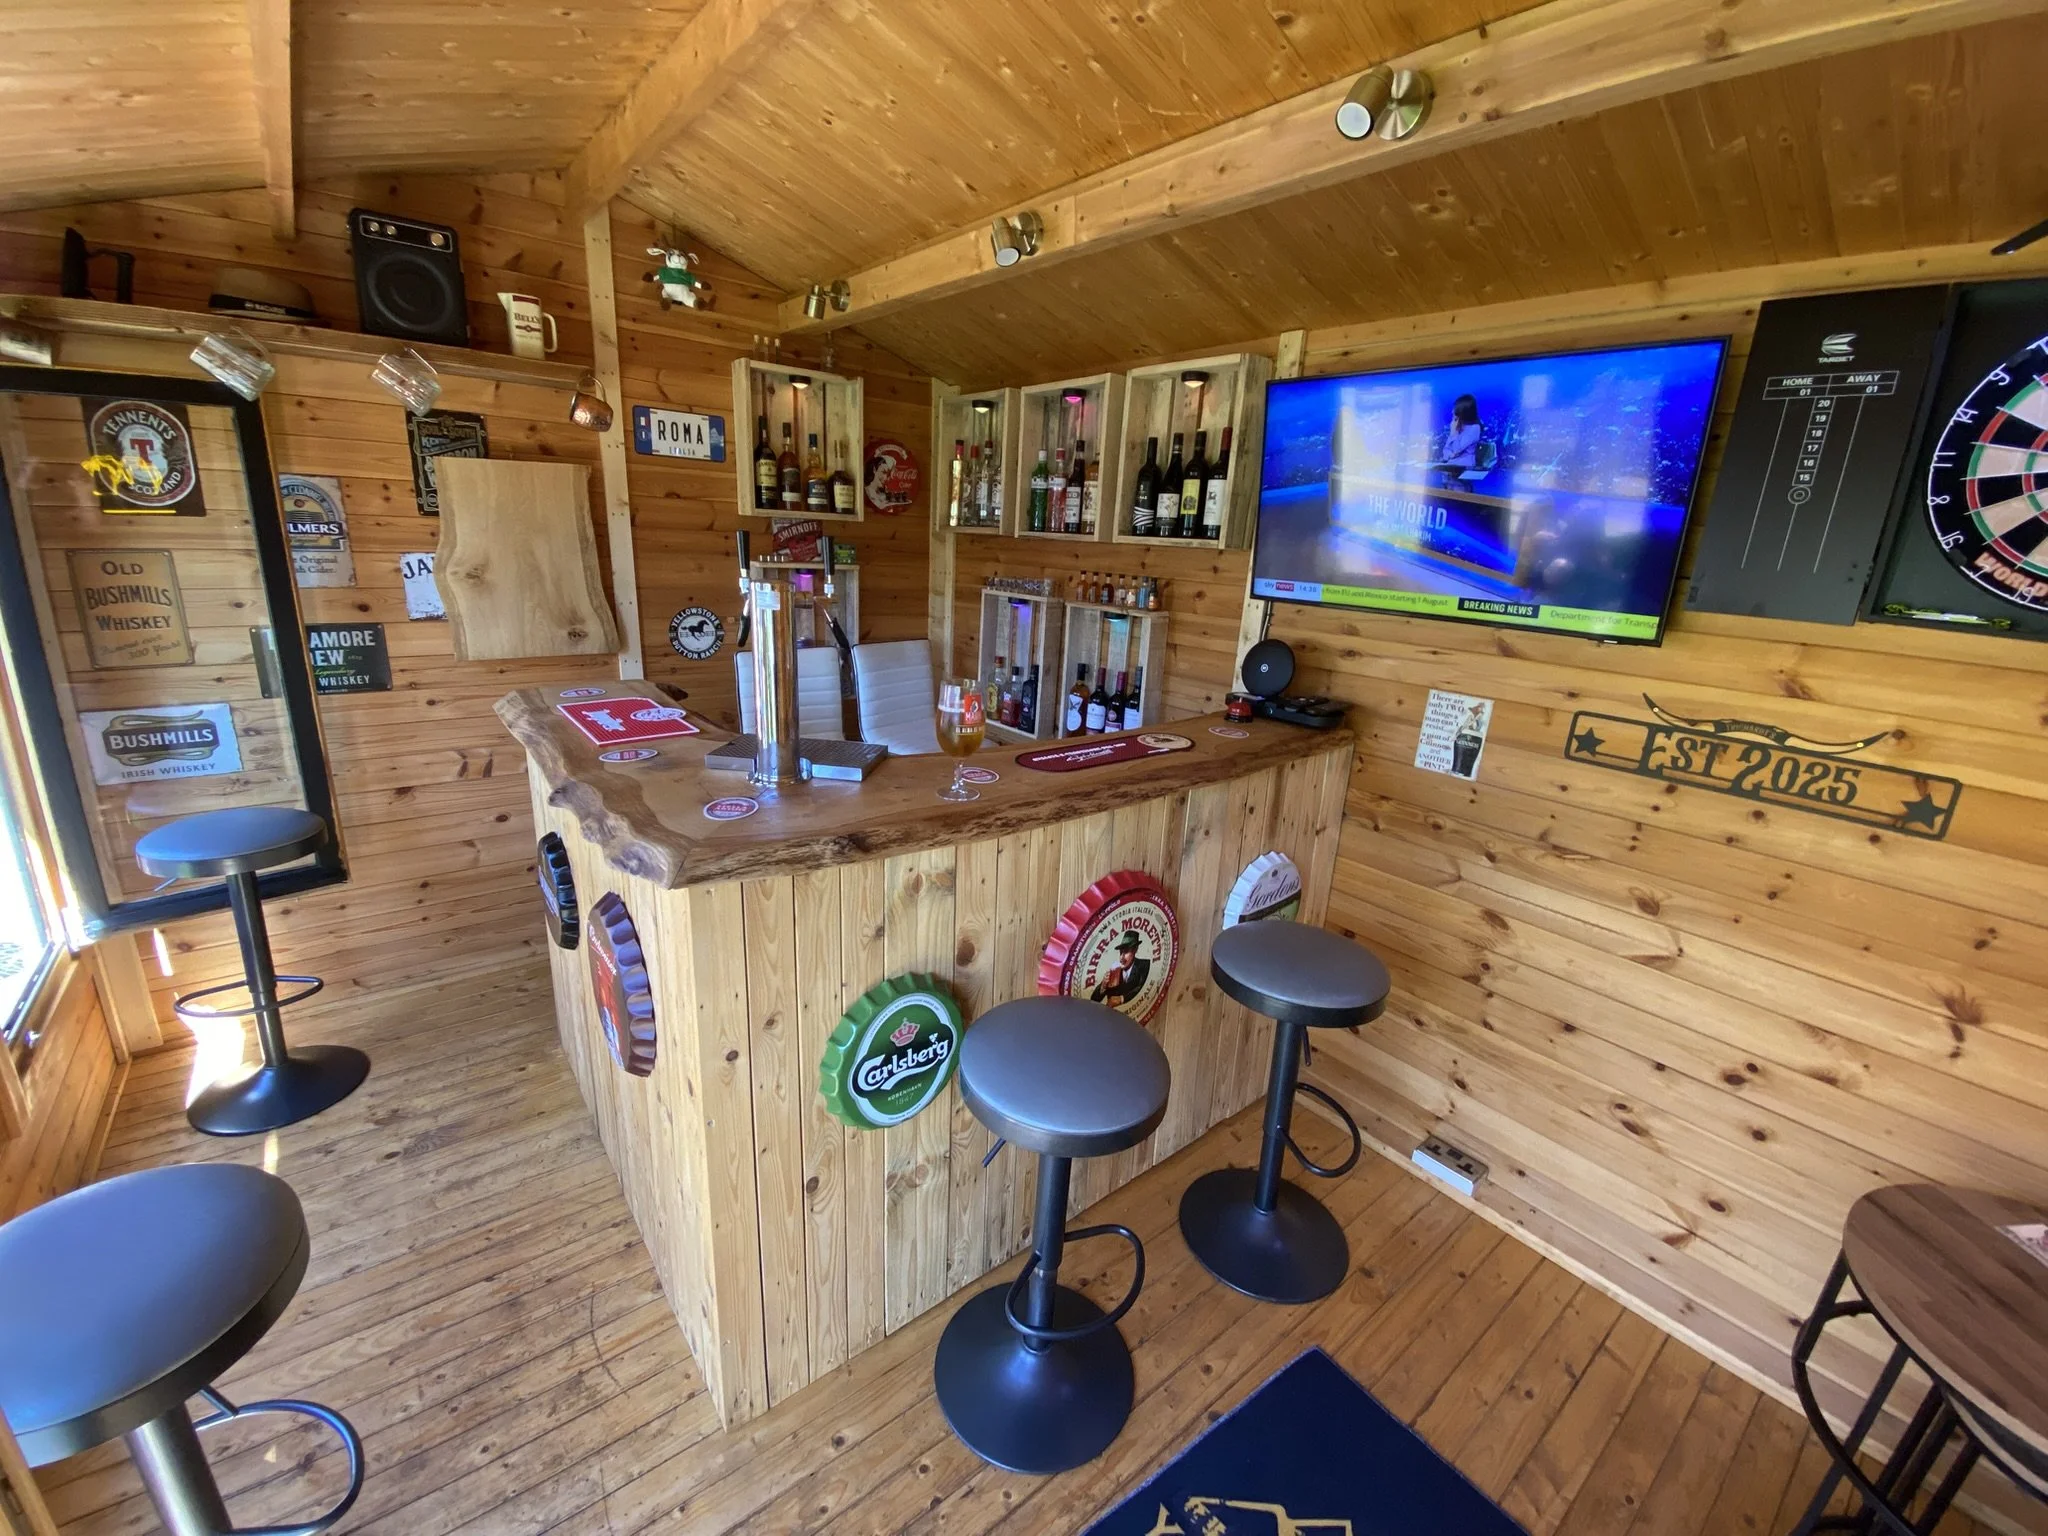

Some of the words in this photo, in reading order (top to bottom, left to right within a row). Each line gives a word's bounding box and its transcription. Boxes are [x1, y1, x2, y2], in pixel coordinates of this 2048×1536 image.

[1818, 355, 1856, 364] TARGET
[1782, 377, 1815, 387] HOME
[1846, 374, 1881, 383] AWAY
[1799, 388, 1811, 396] 01
[1865, 385, 1878, 394] 01
[1817, 399, 1830, 408] 20
[102, 410, 177, 440] TENNENT'S
[1815, 414, 1827, 423] 19
[657, 419, 704, 445] ROMA
[1811, 429, 1823, 438] 18
[669, 446, 696, 456] ITALIA
[1807, 444, 1819, 453] 17
[1803, 459, 1815, 467] 16
[1799, 474, 1811, 482] 15
[1368, 494, 1390, 517] THE
[1393, 499, 1448, 531] WORLD
[287, 522, 340, 534] LMERS
[779, 521, 818, 542] SMIRNOFF
[101, 560, 144, 576] OLD
[300, 555, 338, 567] Original
[403, 556, 434, 579] JA
[84, 584, 173, 610] BUSHMILLS
[1388, 594, 1417, 605] starting
[1422, 596, 1448, 607] August
[1463, 600, 1506, 614] BREAKING
[1507, 604, 1534, 616] NEWS
[95, 615, 172, 632] WHISKEY
[671, 607, 721, 628] YELLOWSTONE
[1550, 609, 1606, 625] Department
[309, 629, 377, 649] AMORE
[318, 674, 371, 687] WHISKEY
[1432, 693, 1453, 702] There
[1445, 704, 1464, 713] TWO
[109, 728, 215, 750] BUSHMILLS
[121, 768, 156, 780] IRISH
[159, 762, 217, 776] WHISKEY
[1638, 726, 1730, 777] EST
[1731, 744, 1863, 806] 2025
[1085, 928, 1119, 989] BIRRA
[1121, 916, 1162, 964] MORETTI
[1124, 979, 1156, 1015] RIGINALE
[857, 1038, 950, 1092] Carlsberg
